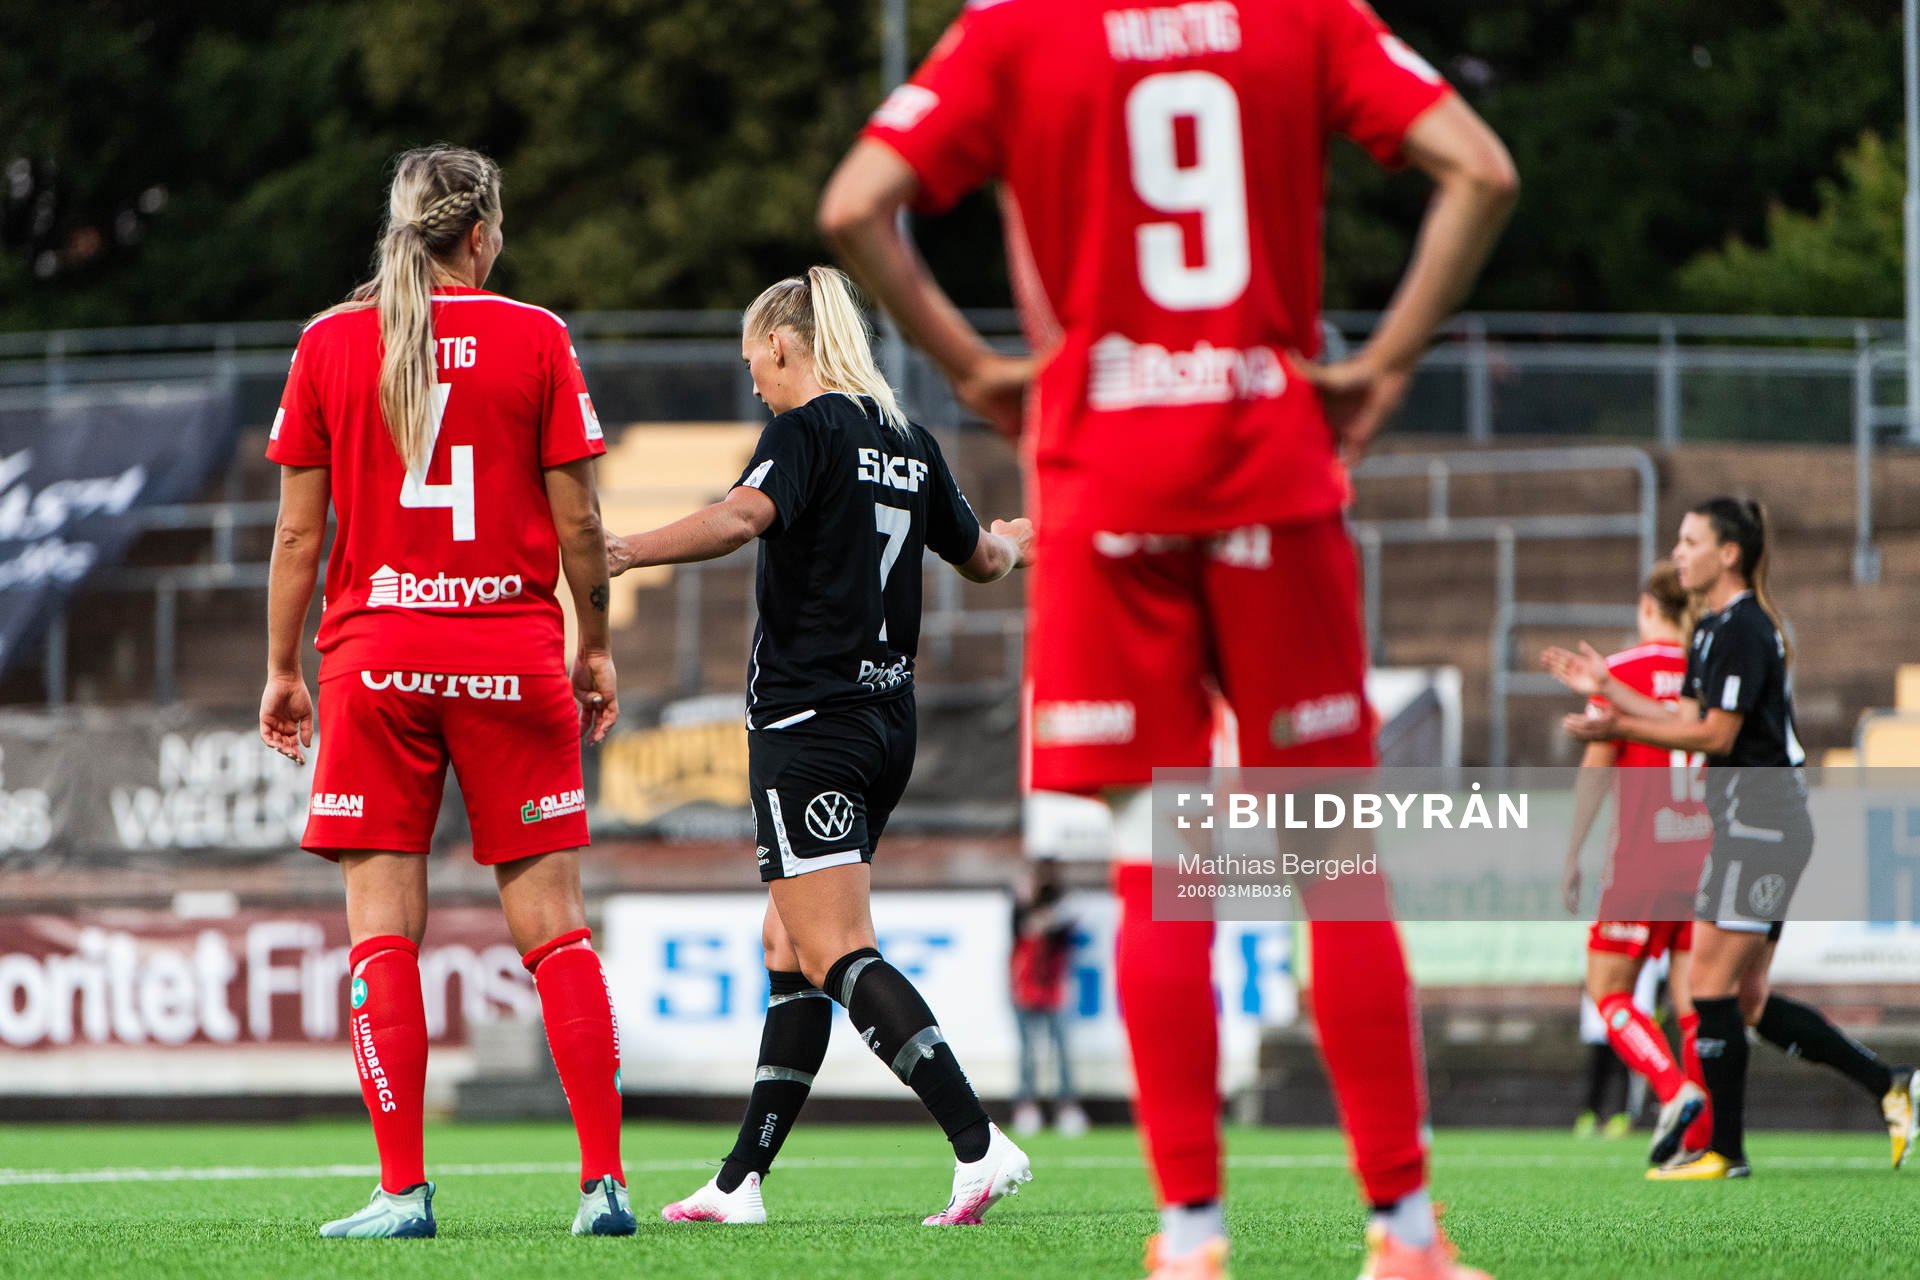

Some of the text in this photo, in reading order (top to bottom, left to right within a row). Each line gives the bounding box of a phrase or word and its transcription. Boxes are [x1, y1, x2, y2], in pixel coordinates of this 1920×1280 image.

[1103, 2, 1241, 61] HURTIG
[1128, 71, 1251, 311] 9
[399, 382, 476, 541] 4
[857, 448, 929, 493] SKF
[874, 502, 911, 642] 7
[358, 1013, 397, 1113] LUNDBERGS
[758, 1112, 778, 1148] umbro
